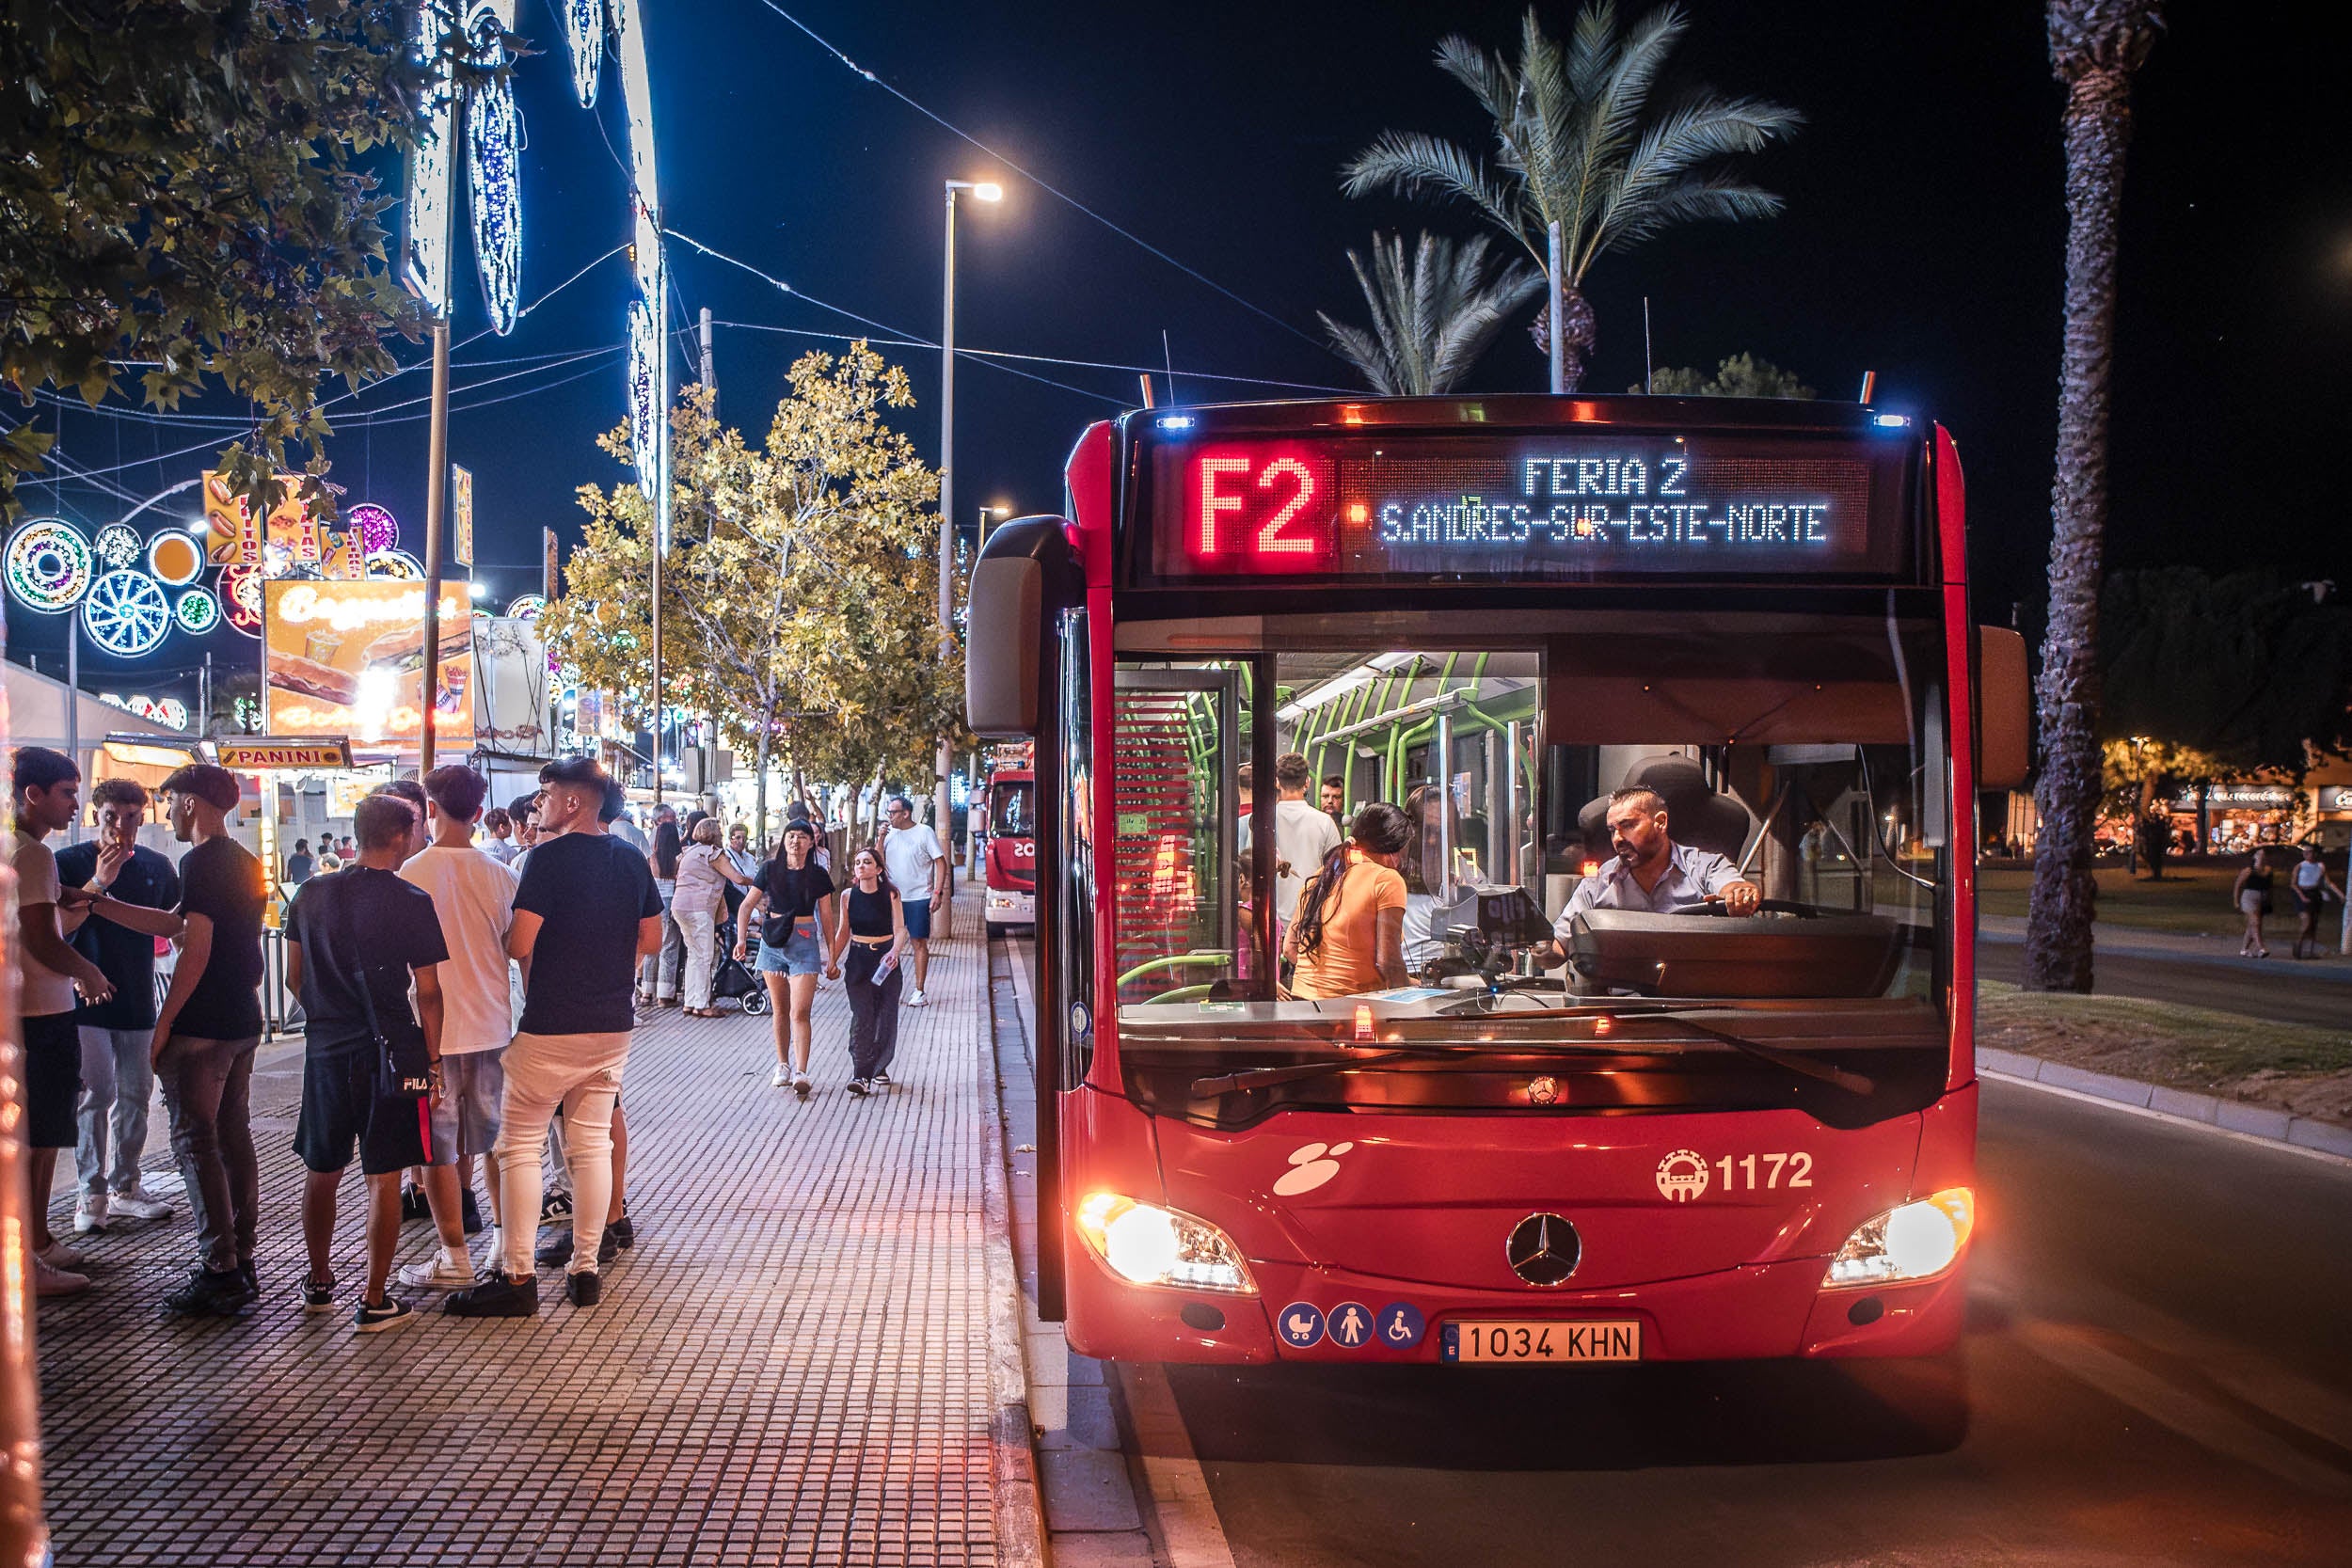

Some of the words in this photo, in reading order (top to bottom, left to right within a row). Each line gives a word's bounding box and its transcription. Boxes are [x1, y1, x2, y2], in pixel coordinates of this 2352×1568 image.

[1524, 456, 1647, 497] FERIA
[1199, 456, 1316, 555] F2
[1380, 503, 1829, 544] S.ANDRES-SUR-ESTE-NORTE
[238, 751, 322, 764] PANINI
[404, 1077, 428, 1090] FILA
[1714, 1151, 1813, 1192] 1172
[1470, 1327, 1554, 1357] 1034
[1568, 1327, 1631, 1357] KHN
